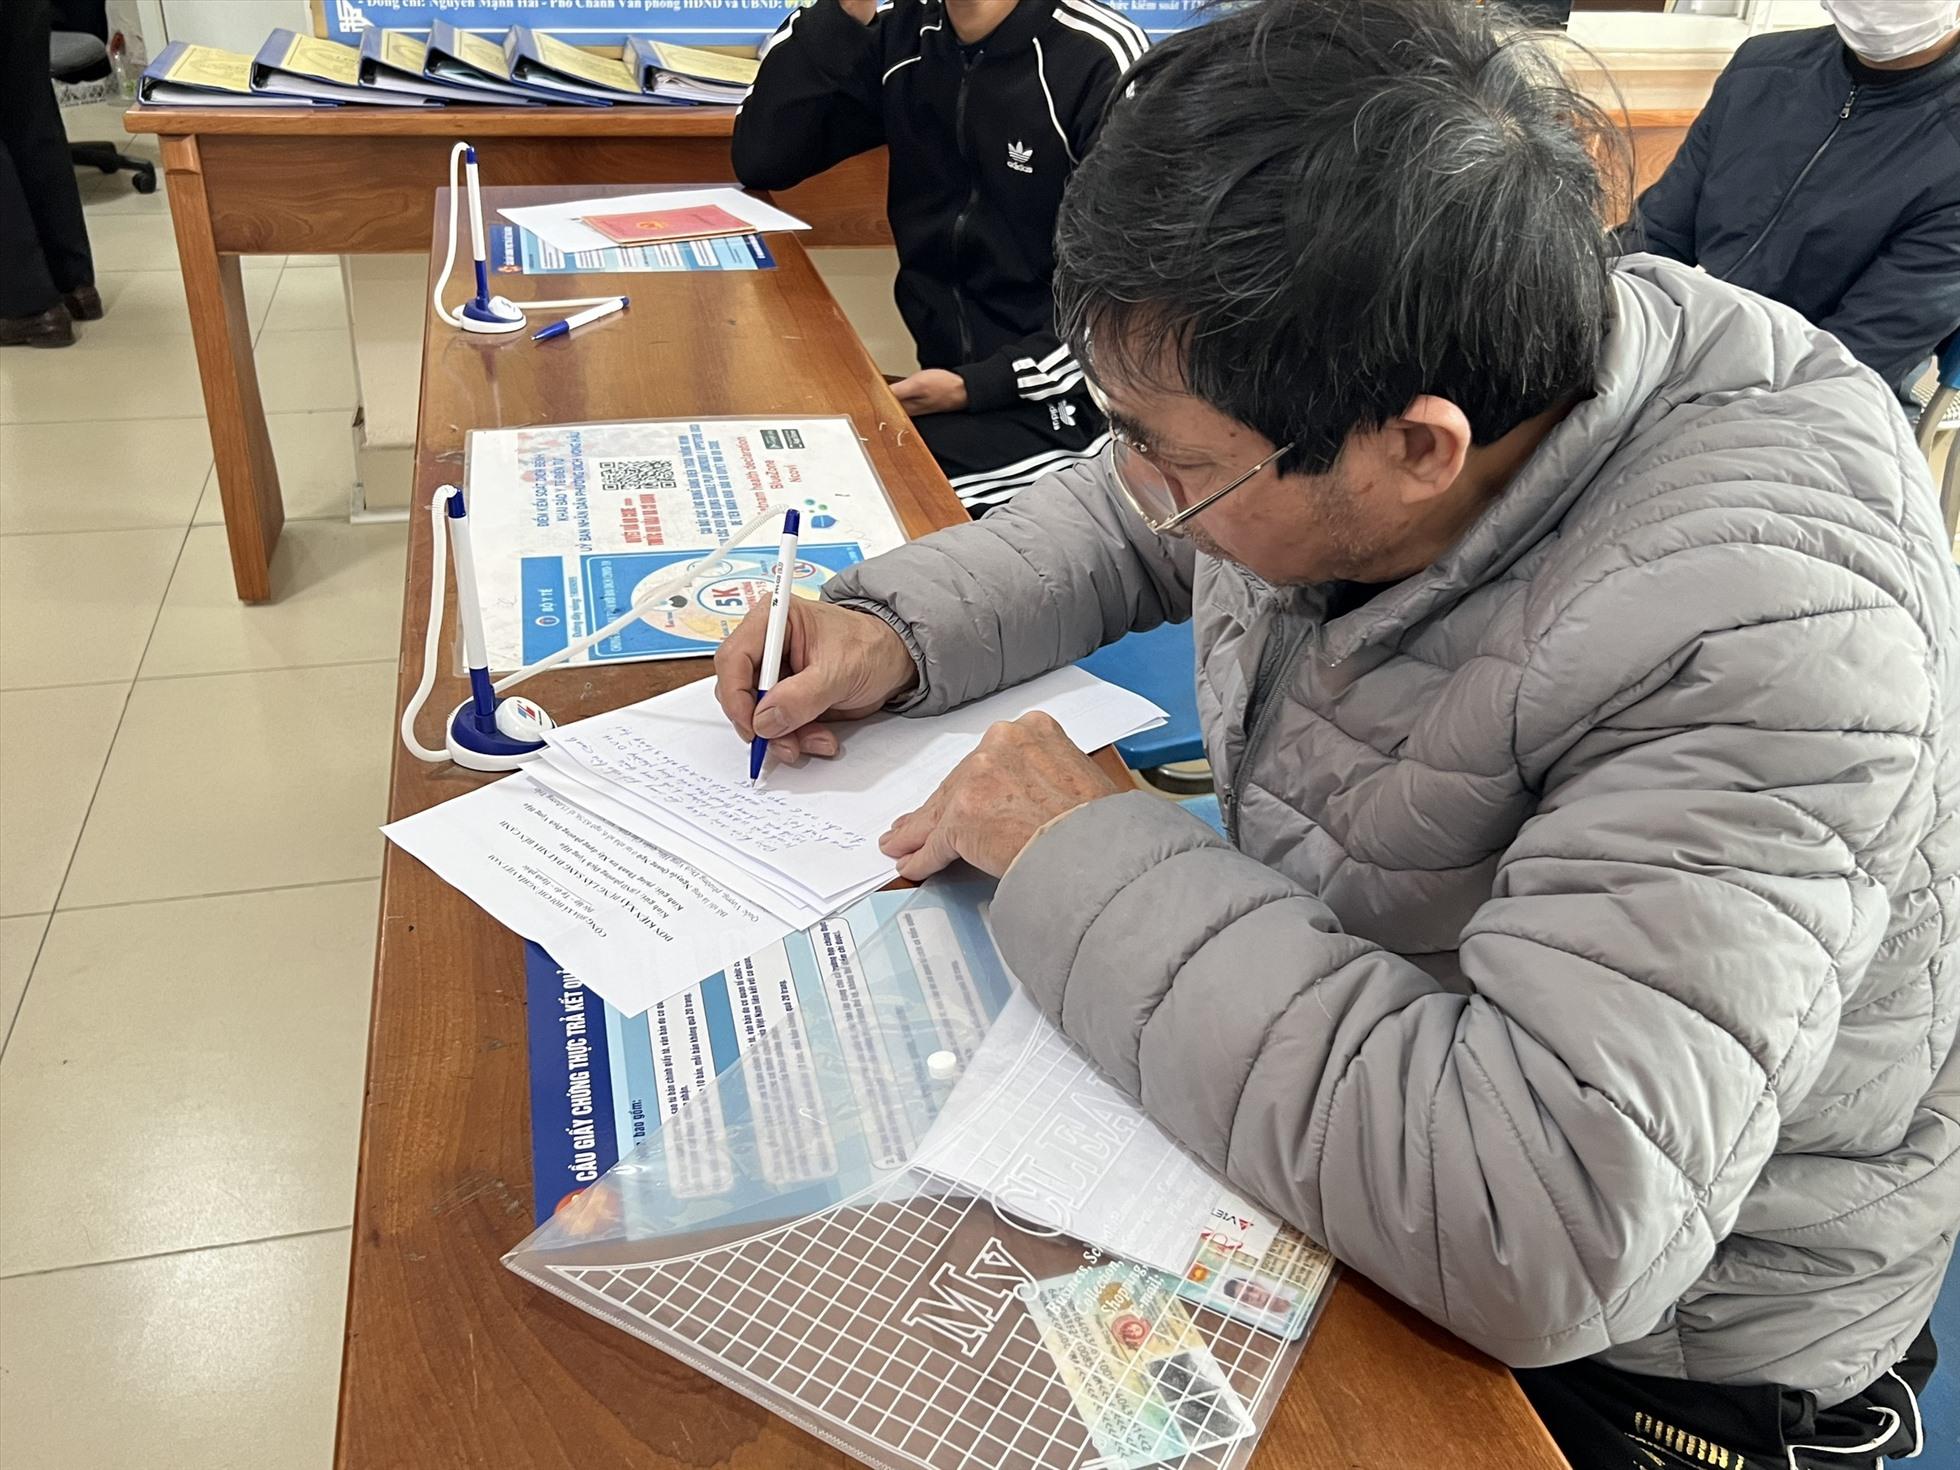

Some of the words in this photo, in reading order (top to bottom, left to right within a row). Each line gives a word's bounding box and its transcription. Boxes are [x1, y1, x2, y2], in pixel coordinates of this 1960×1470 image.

[732, 436, 756, 469] declaration
[743, 471, 764, 490] health
[761, 459, 784, 488] BlueZone
[711, 587, 743, 606] 5K
[556, 990, 584, 1012] KẾT
[558, 1013, 586, 1037] TRẢ
[566, 1037, 593, 1069] THỰC
[566, 1070, 594, 1116] CHỨNG
[627, 1098, 645, 1120] gồm:
[563, 1117, 595, 1151] GIẤY
[632, 1120, 646, 1137] bao
[566, 1151, 598, 1183] CẦU
[902, 1236, 1041, 1357] My
[1100, 1264, 1150, 1316] Shopping,
